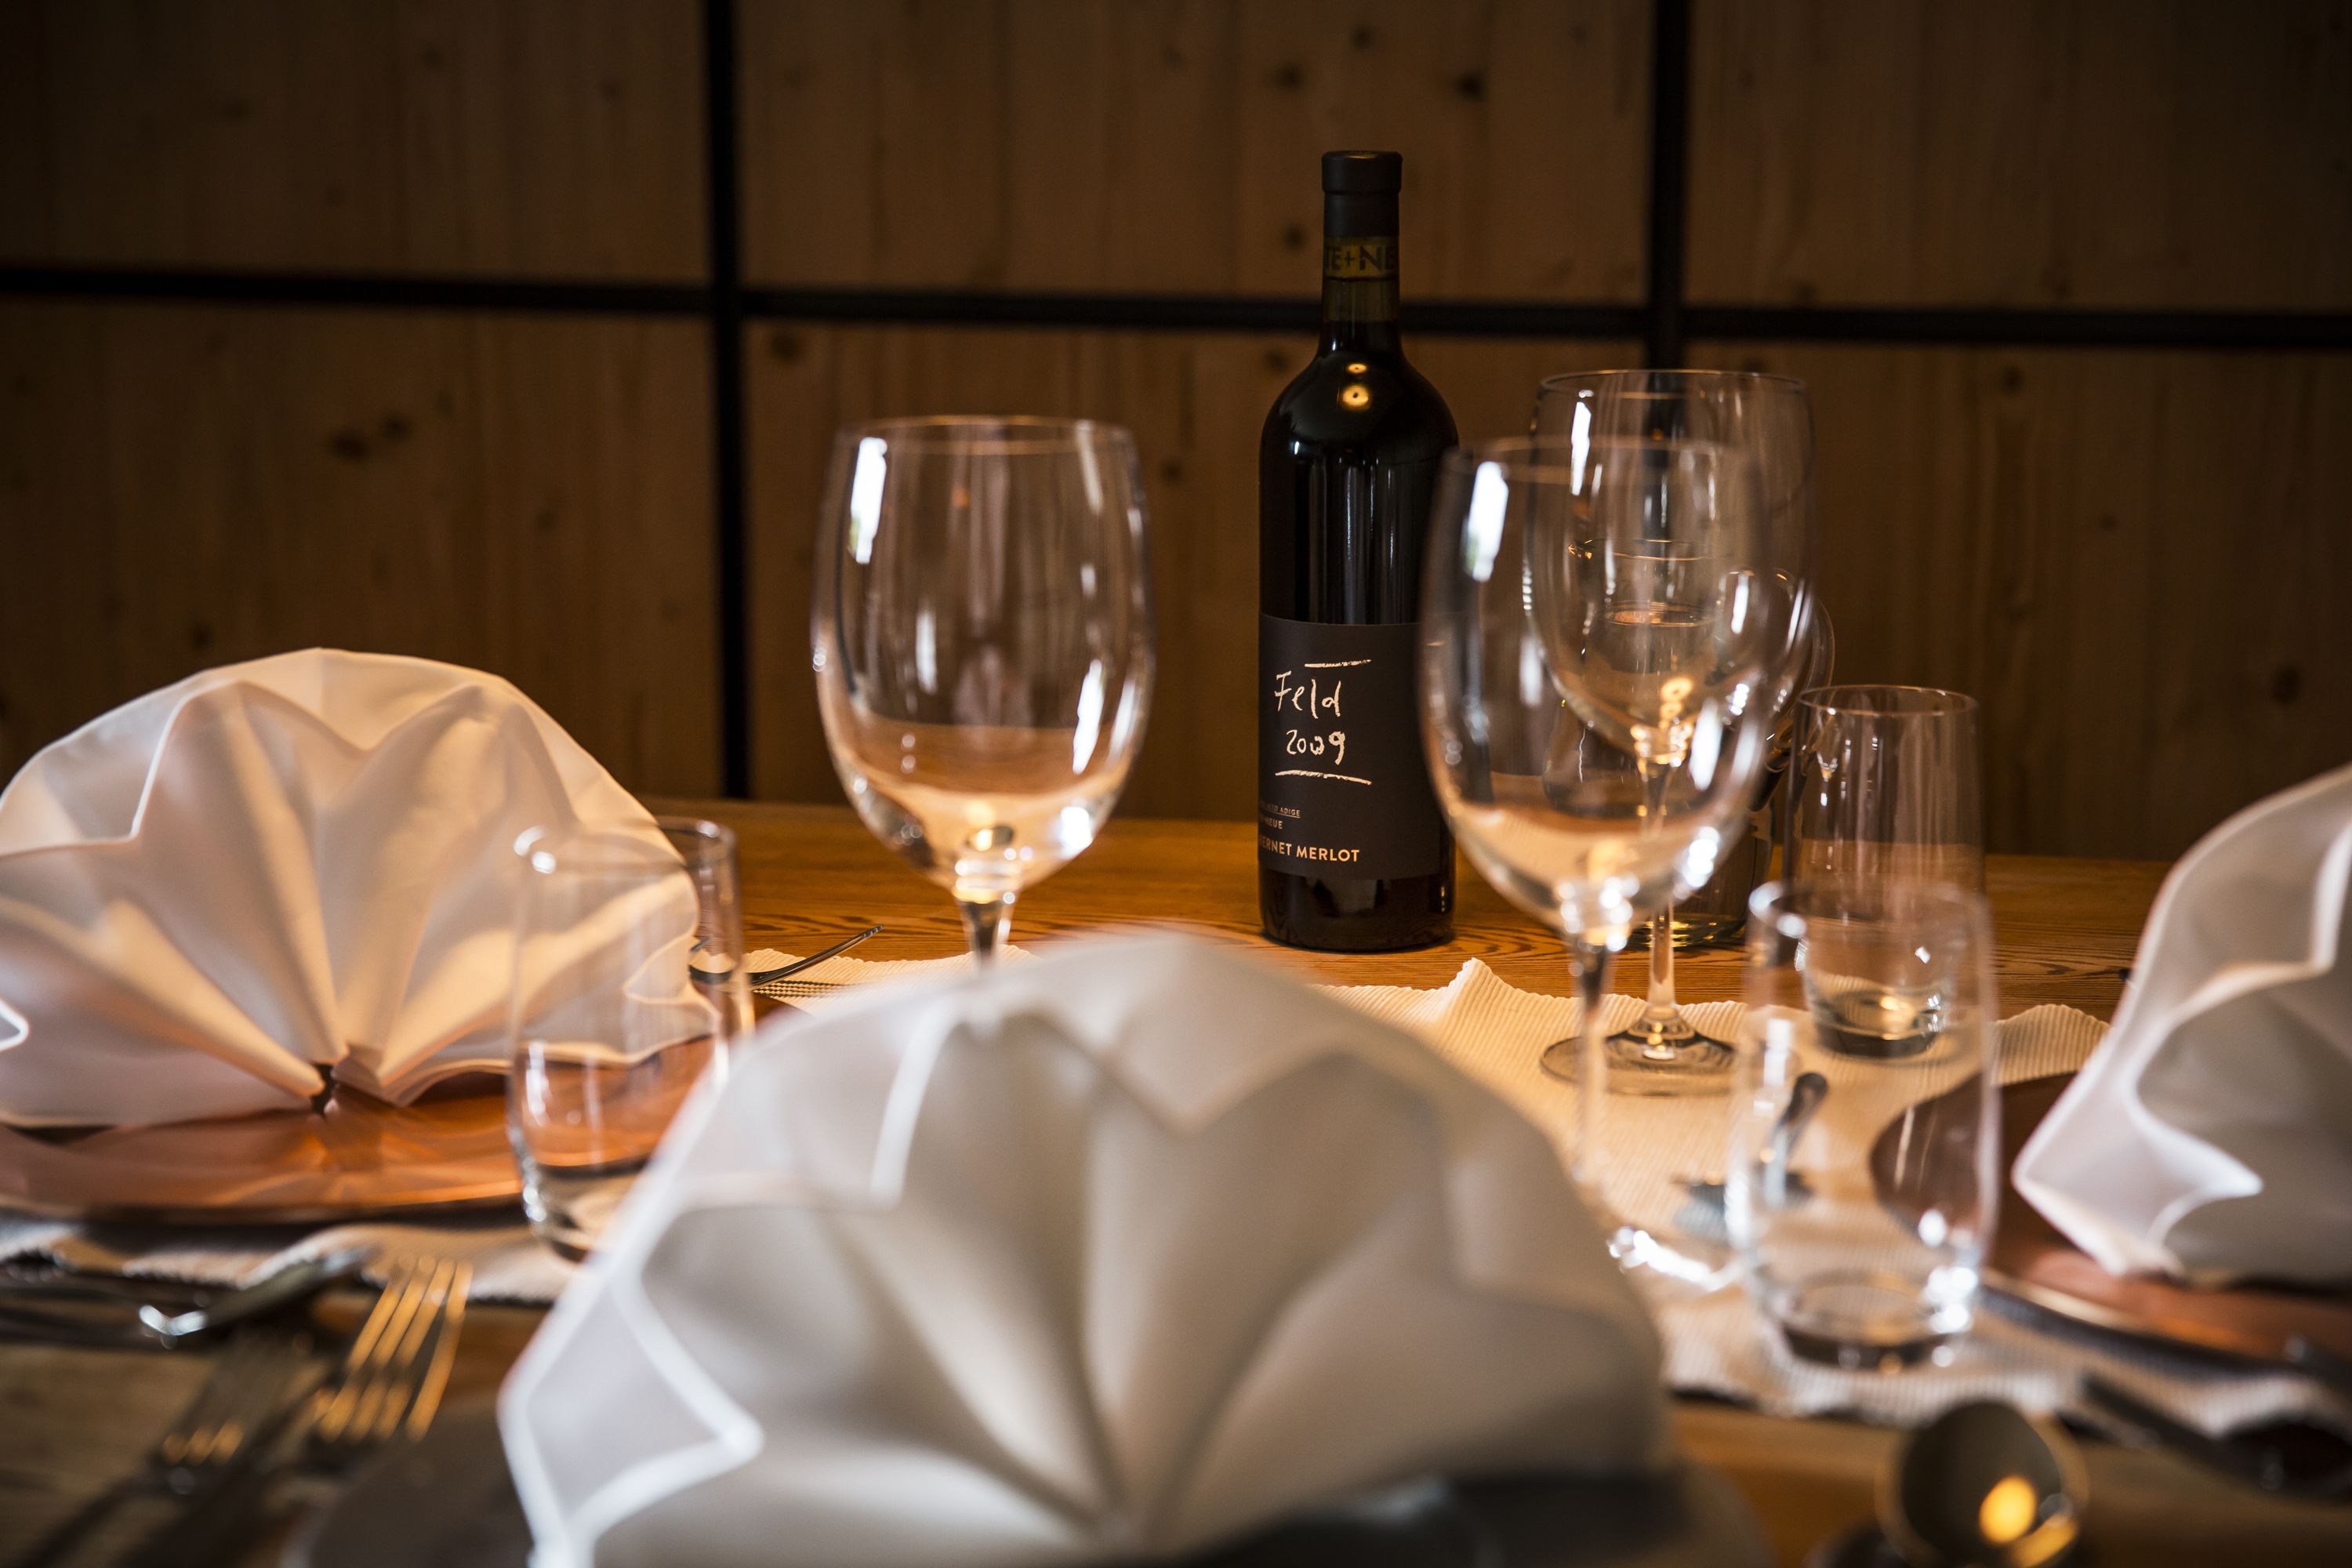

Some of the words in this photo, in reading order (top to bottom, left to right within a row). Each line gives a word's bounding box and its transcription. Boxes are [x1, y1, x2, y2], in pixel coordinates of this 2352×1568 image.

[1274, 670, 1341, 719] Feld
[1286, 729, 1346, 766] 2009
[1279, 807, 1301, 817] ADIGE
[1296, 844, 1360, 862] MERLOT
